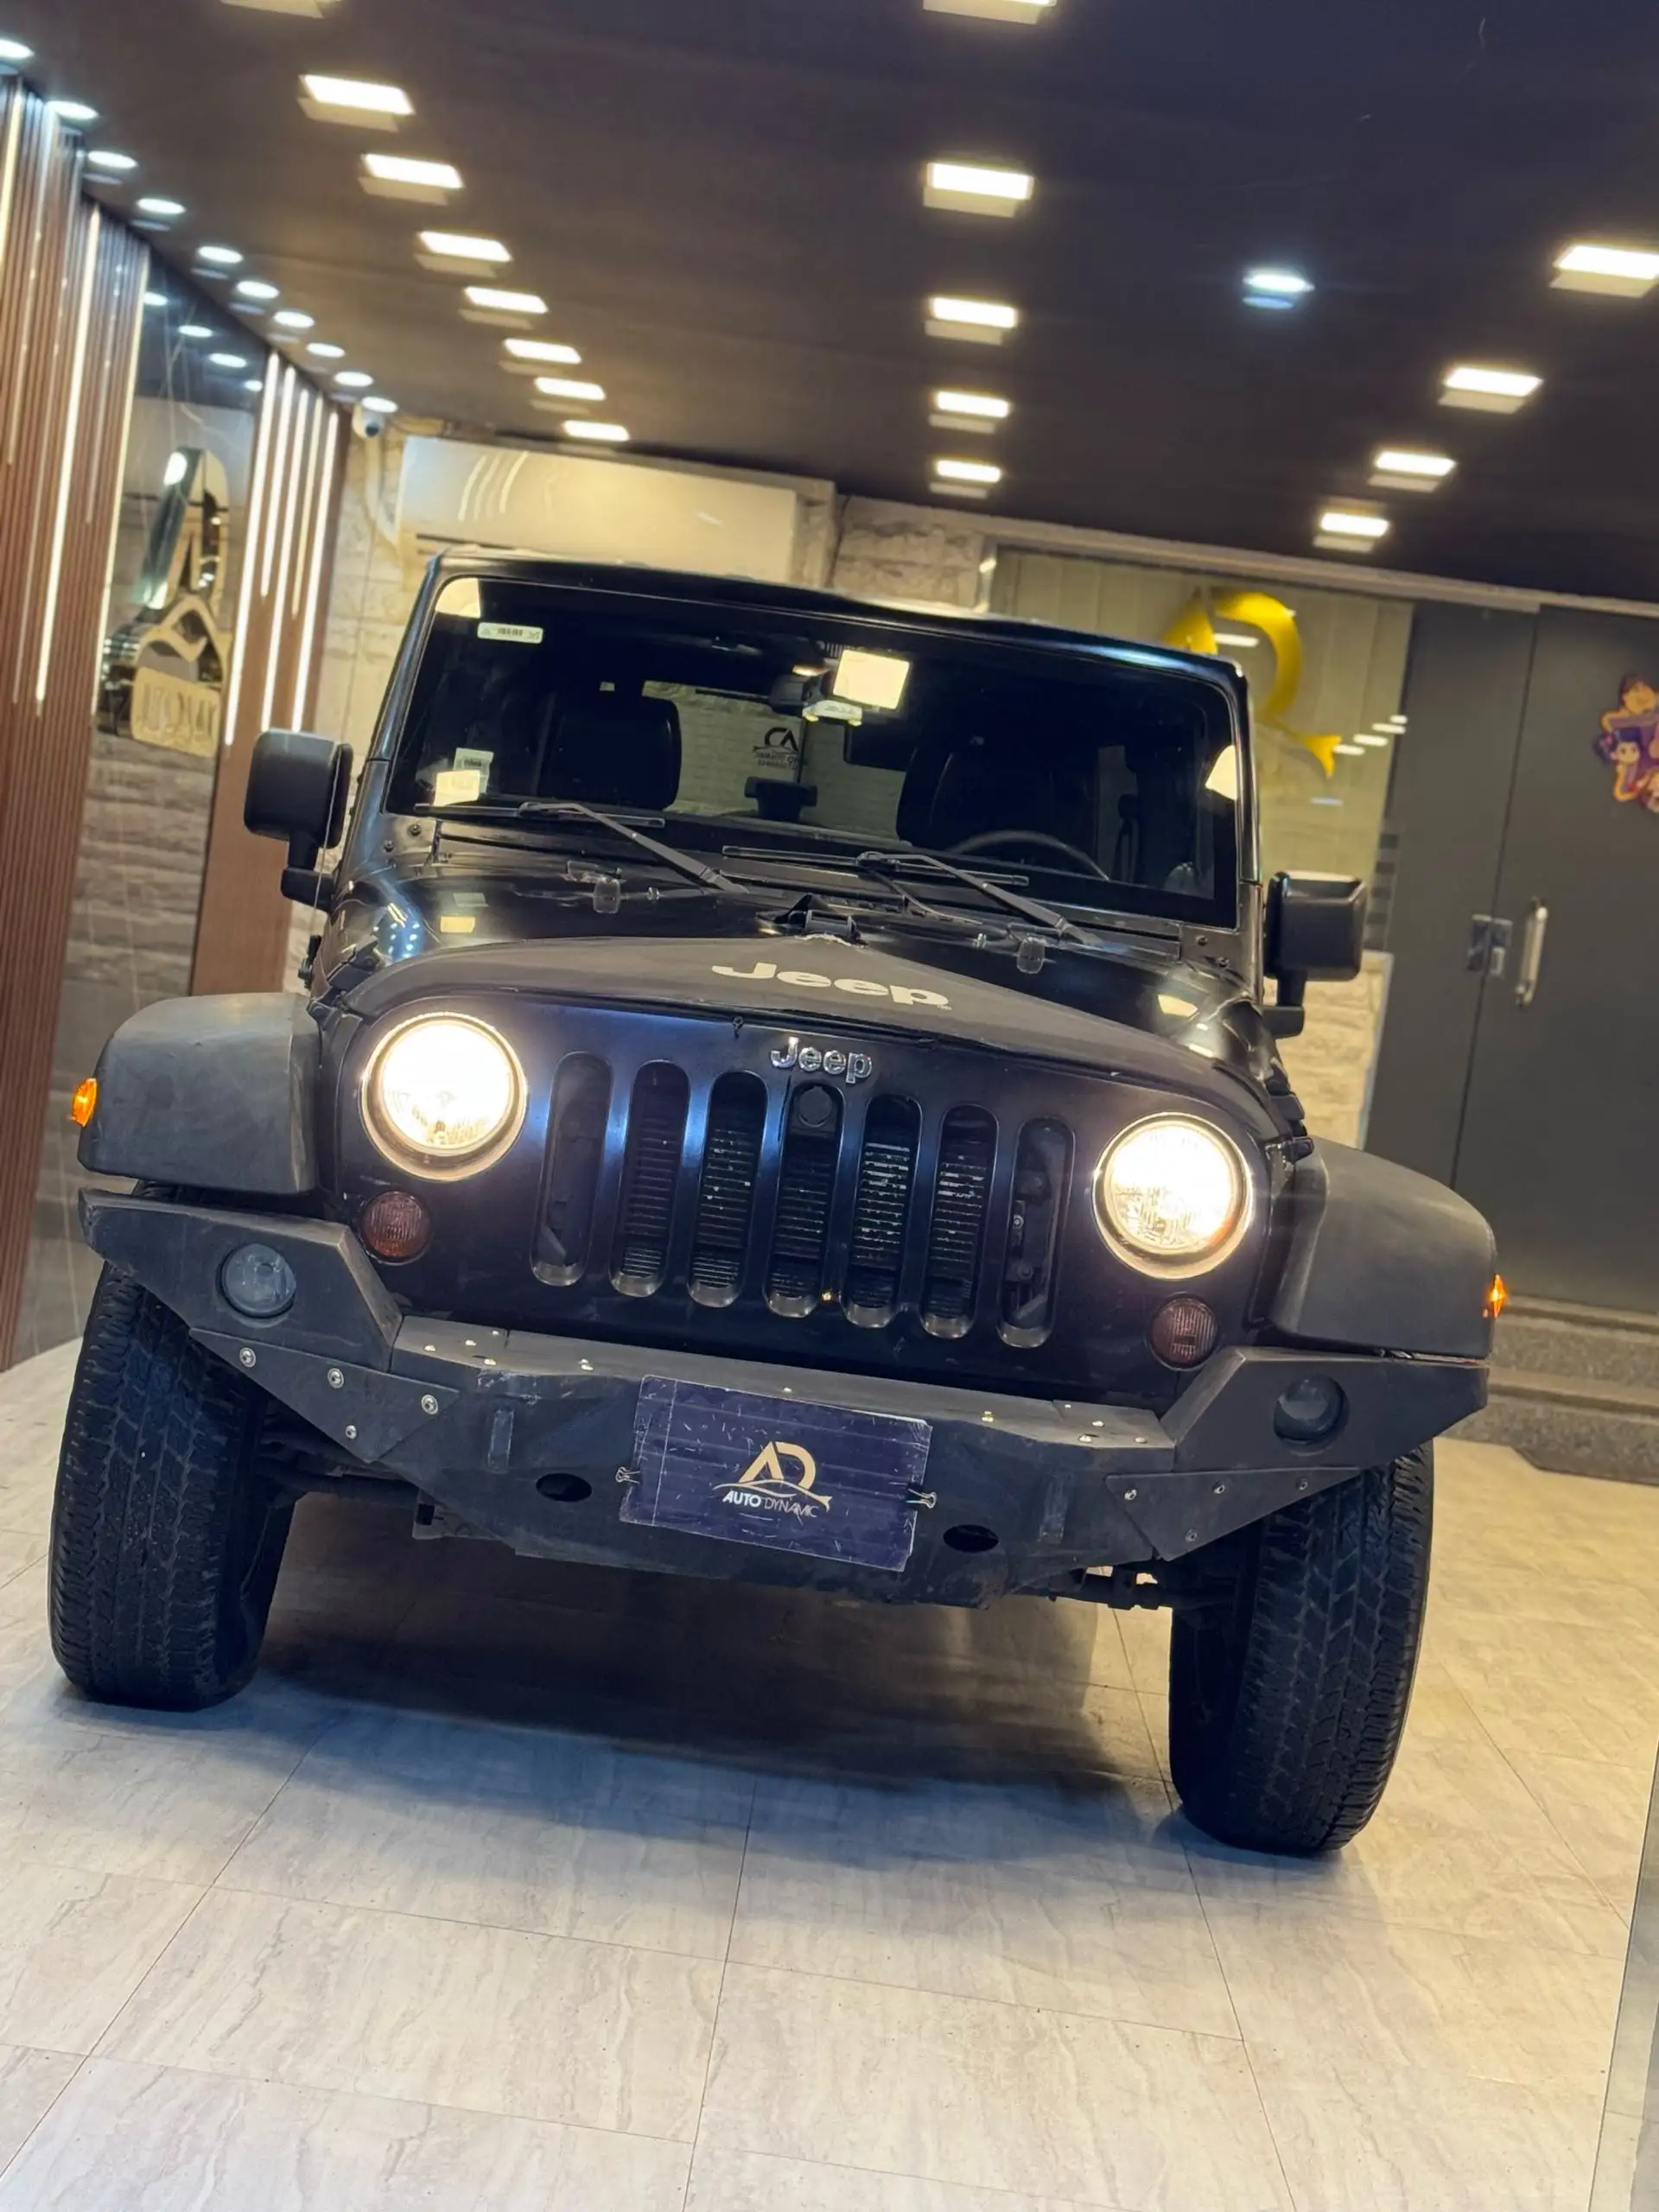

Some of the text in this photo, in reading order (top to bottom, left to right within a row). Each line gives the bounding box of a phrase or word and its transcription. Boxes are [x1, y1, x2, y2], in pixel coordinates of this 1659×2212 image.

[711, 962, 950, 1006] Jeep
[770, 1037, 873, 1084] Jeep
[722, 1490, 762, 1508] AUTO
